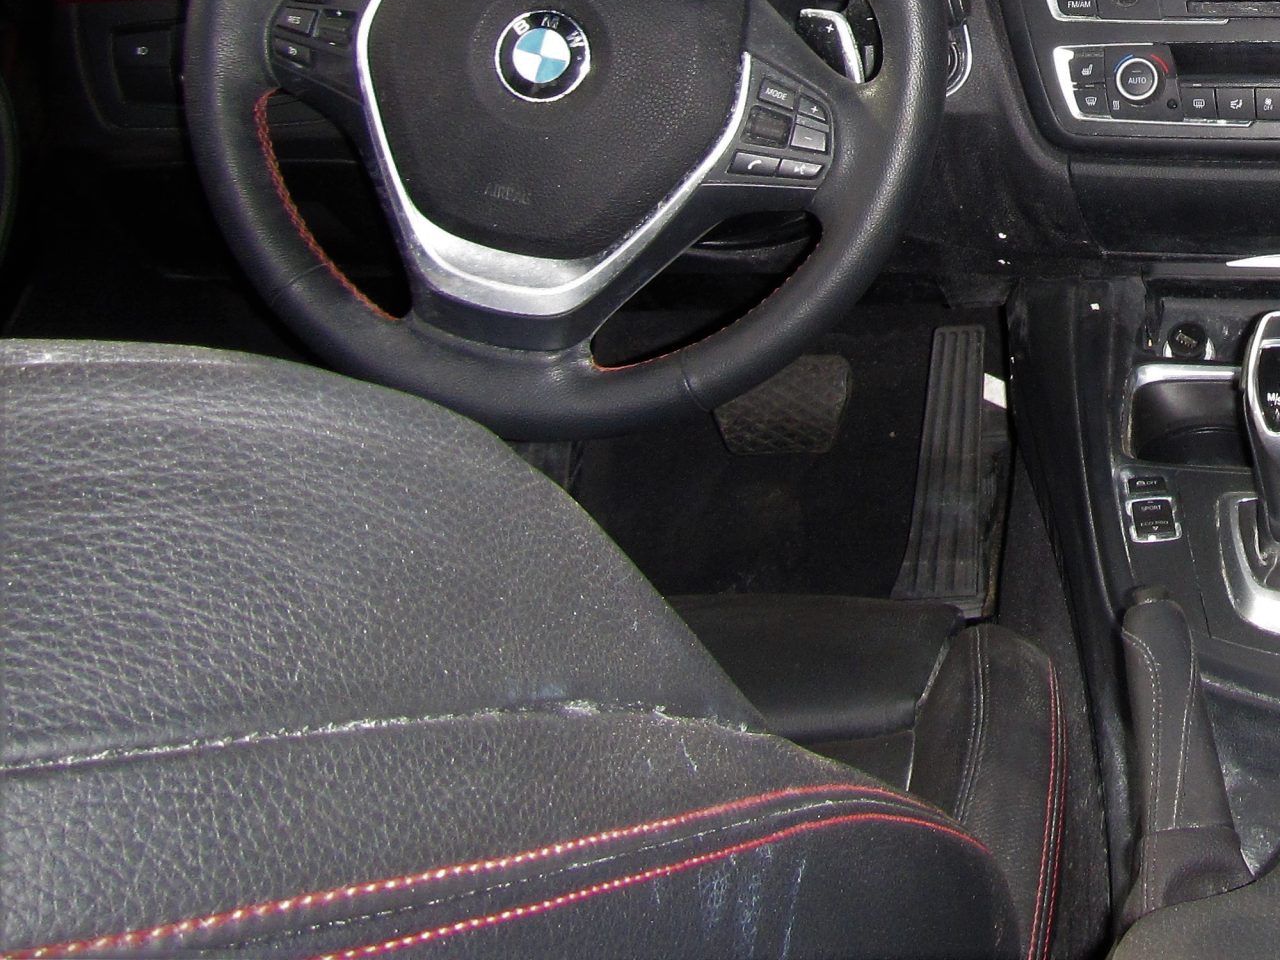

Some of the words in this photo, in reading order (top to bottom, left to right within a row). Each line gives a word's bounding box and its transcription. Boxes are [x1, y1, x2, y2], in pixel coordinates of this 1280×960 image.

[1067, 0, 1091, 9] FM/AM
[513, 16, 585, 48] BMW
[1127, 76, 1147, 85] AUTO
[765, 87, 788, 100] MODE
